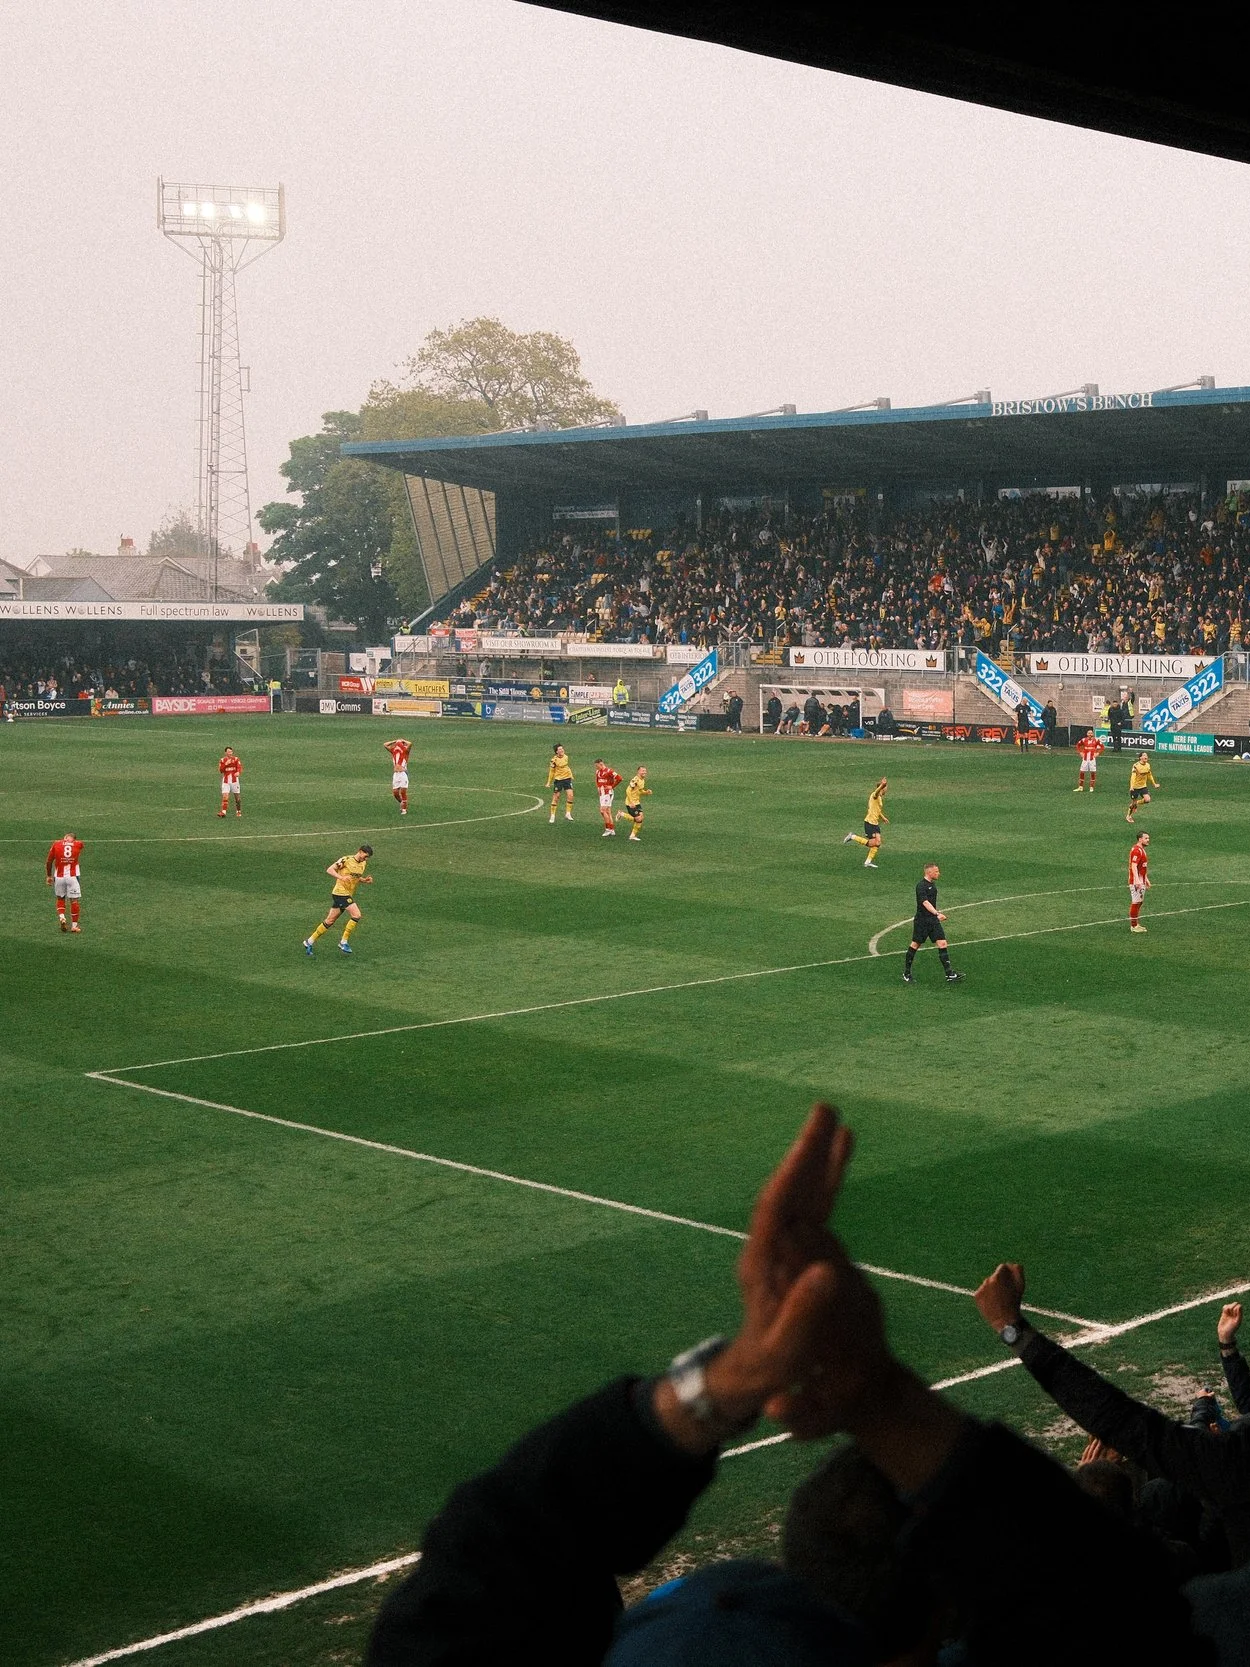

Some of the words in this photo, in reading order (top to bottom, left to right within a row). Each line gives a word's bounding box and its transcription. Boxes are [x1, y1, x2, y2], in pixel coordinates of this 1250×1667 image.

[992, 397, 1088, 416] BRISTOW'S
[1091, 392, 1153, 411] BENCH
[140, 605, 158, 616] Full
[160, 605, 210, 619] spectrum
[212, 606, 229, 617] law
[813, 652, 840, 665] OTB
[843, 652, 917, 668] FLOORING
[1058, 656, 1089, 672] OTB
[1093, 657, 1184, 676] DRYLINING
[693, 662, 716, 687] 322
[976, 664, 1004, 694] 322
[414, 683, 446, 693] THATCHERS
[1189, 672, 1220, 702] 322
[13, 701, 36, 711] itson
[37, 700, 66, 712] Boyce
[155, 699, 196, 713] BAYSIDE
[320, 700, 335, 712] JMV
[336, 701, 362, 713] Comms
[1171, 695, 1190, 711] TAXIS
[1143, 708, 1173, 733] 322
[981, 727, 1008, 740] REV
[1173, 735, 1187, 743] HERE
[1187, 736, 1197, 744] FOR
[1099, 734, 1156, 748] enrprise
[1167, 743, 1194, 752] NATIONAL
[1194, 744, 1213, 753] LEAGUE
[1214, 739, 1235, 748] VX3
[64, 845, 73, 858] 8
